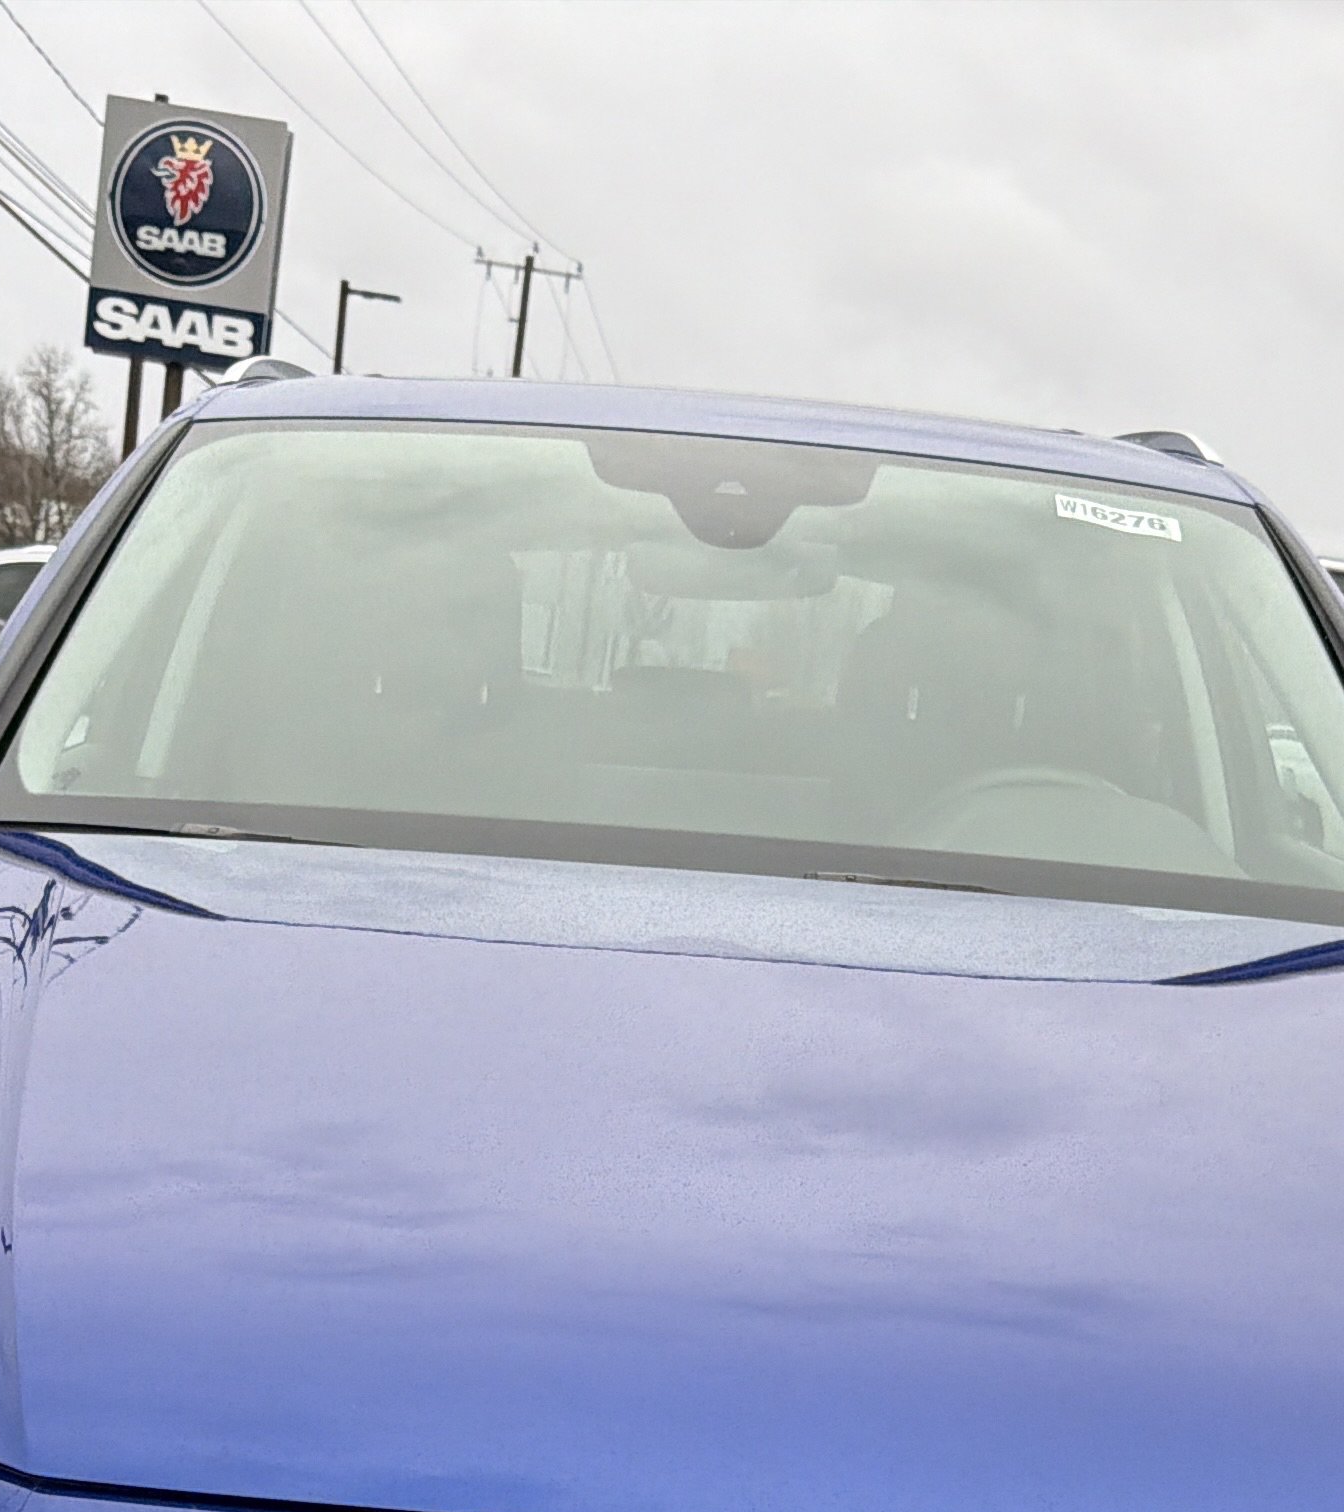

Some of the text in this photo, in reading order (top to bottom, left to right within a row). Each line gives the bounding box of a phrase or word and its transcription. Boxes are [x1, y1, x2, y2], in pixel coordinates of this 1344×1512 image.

[136, 225, 227, 259] SAAB
[92, 296, 255, 358] SAAB
[1059, 498, 1167, 531] W16276
